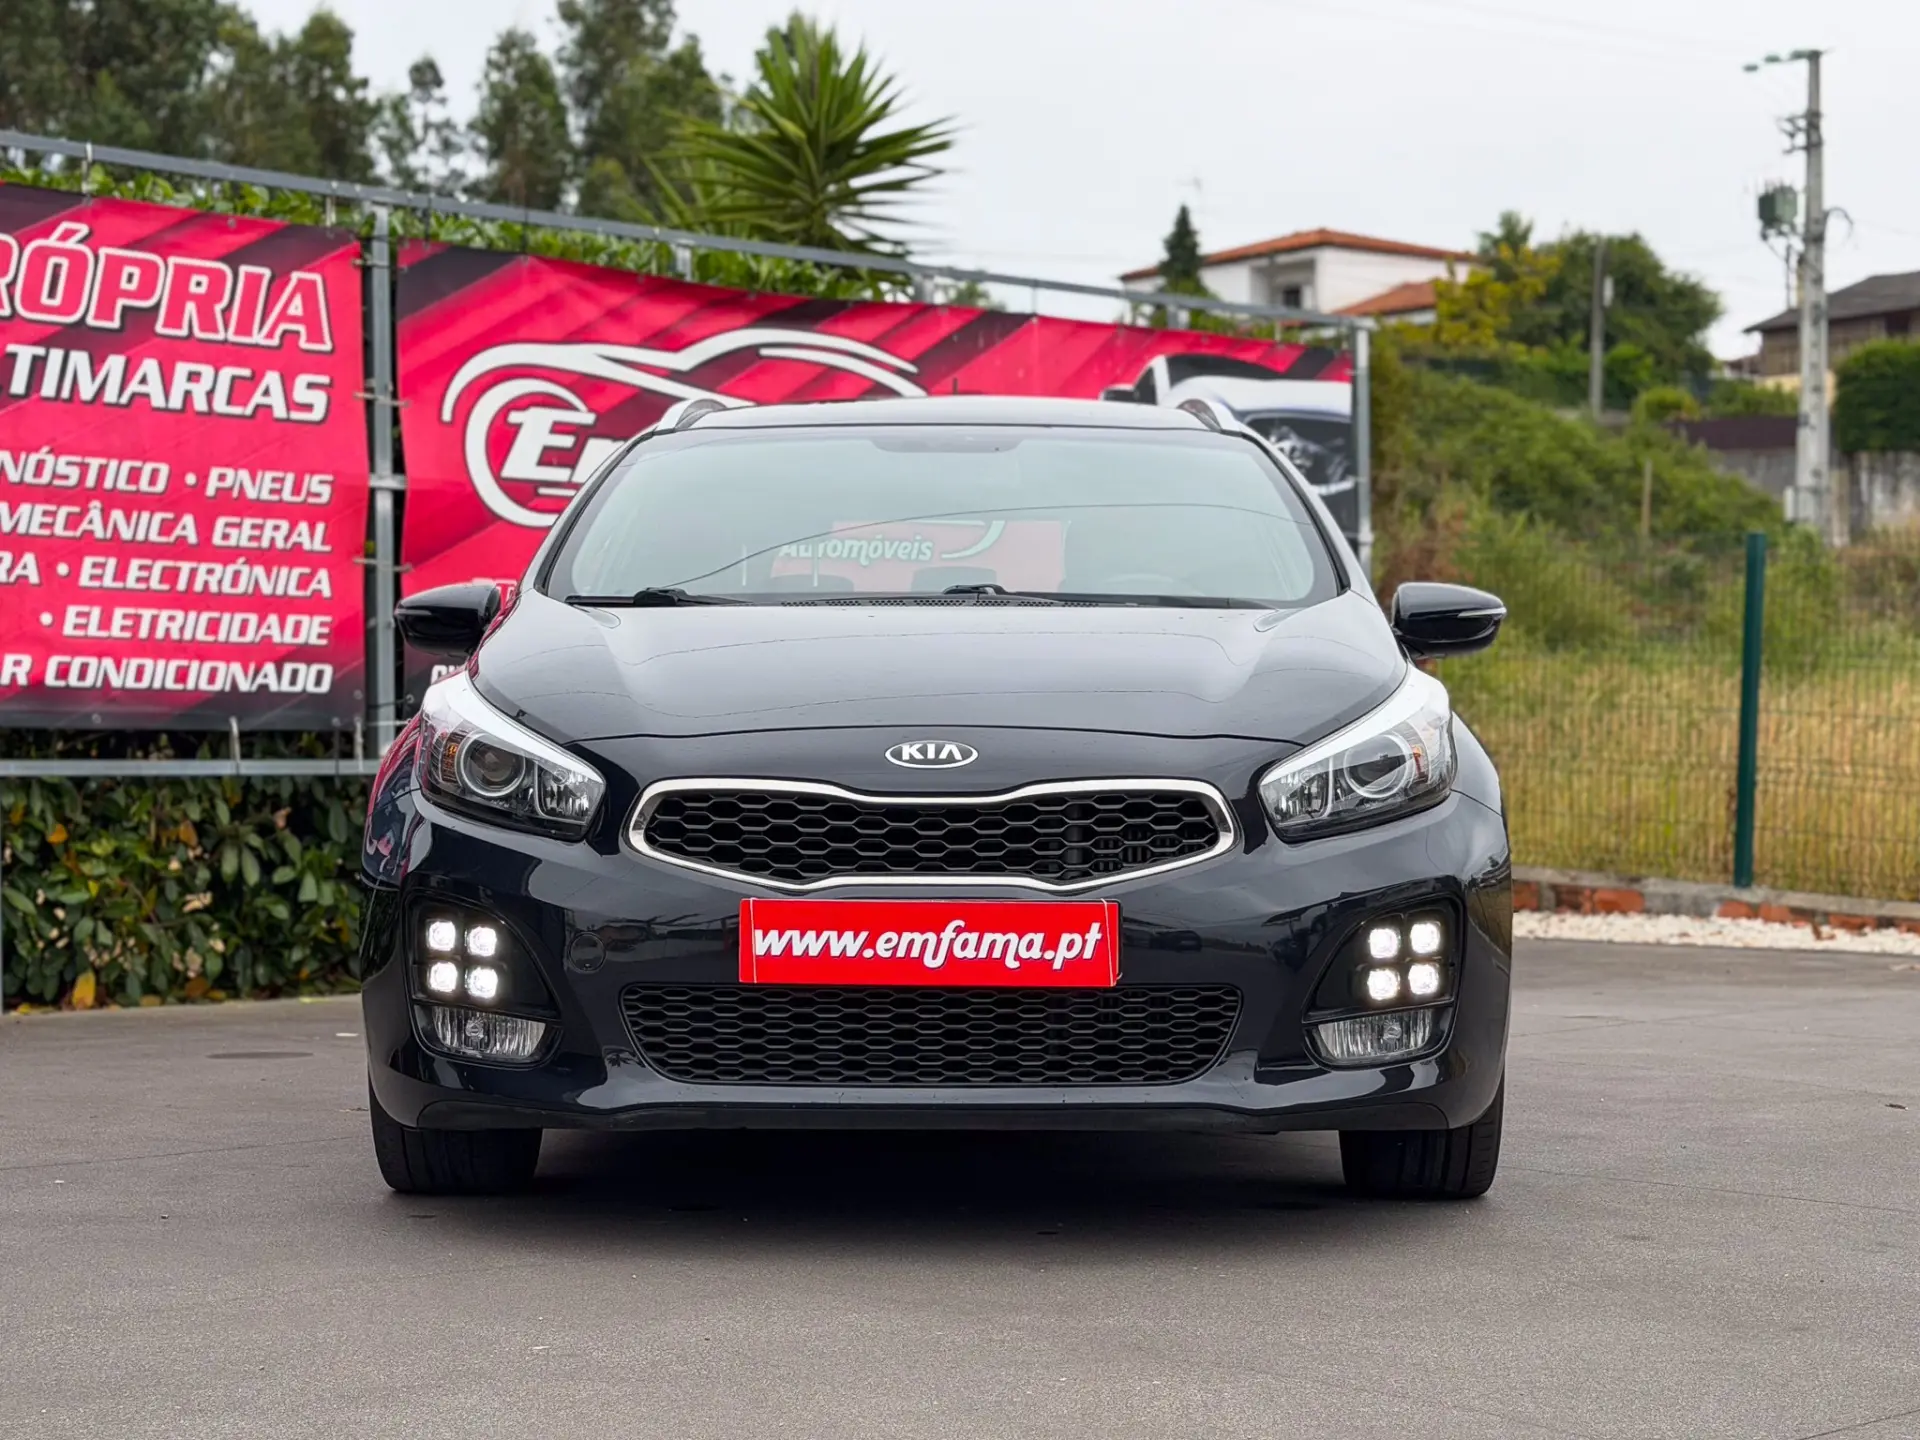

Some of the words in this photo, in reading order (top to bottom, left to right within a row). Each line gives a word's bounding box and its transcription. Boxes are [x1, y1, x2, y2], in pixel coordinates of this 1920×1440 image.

[7, 344, 331, 422] TIMARCAS
[205, 467, 334, 504] PNEUS
[212, 516, 332, 552] GERAL
[78, 556, 332, 598] ELECTRÓNICA
[62, 605, 332, 645] ELETRICIDADE
[44, 656, 333, 693] CONDICIONADO
[901, 743, 963, 761] KIA
[754, 920, 1102, 970] www.emfama.pt
